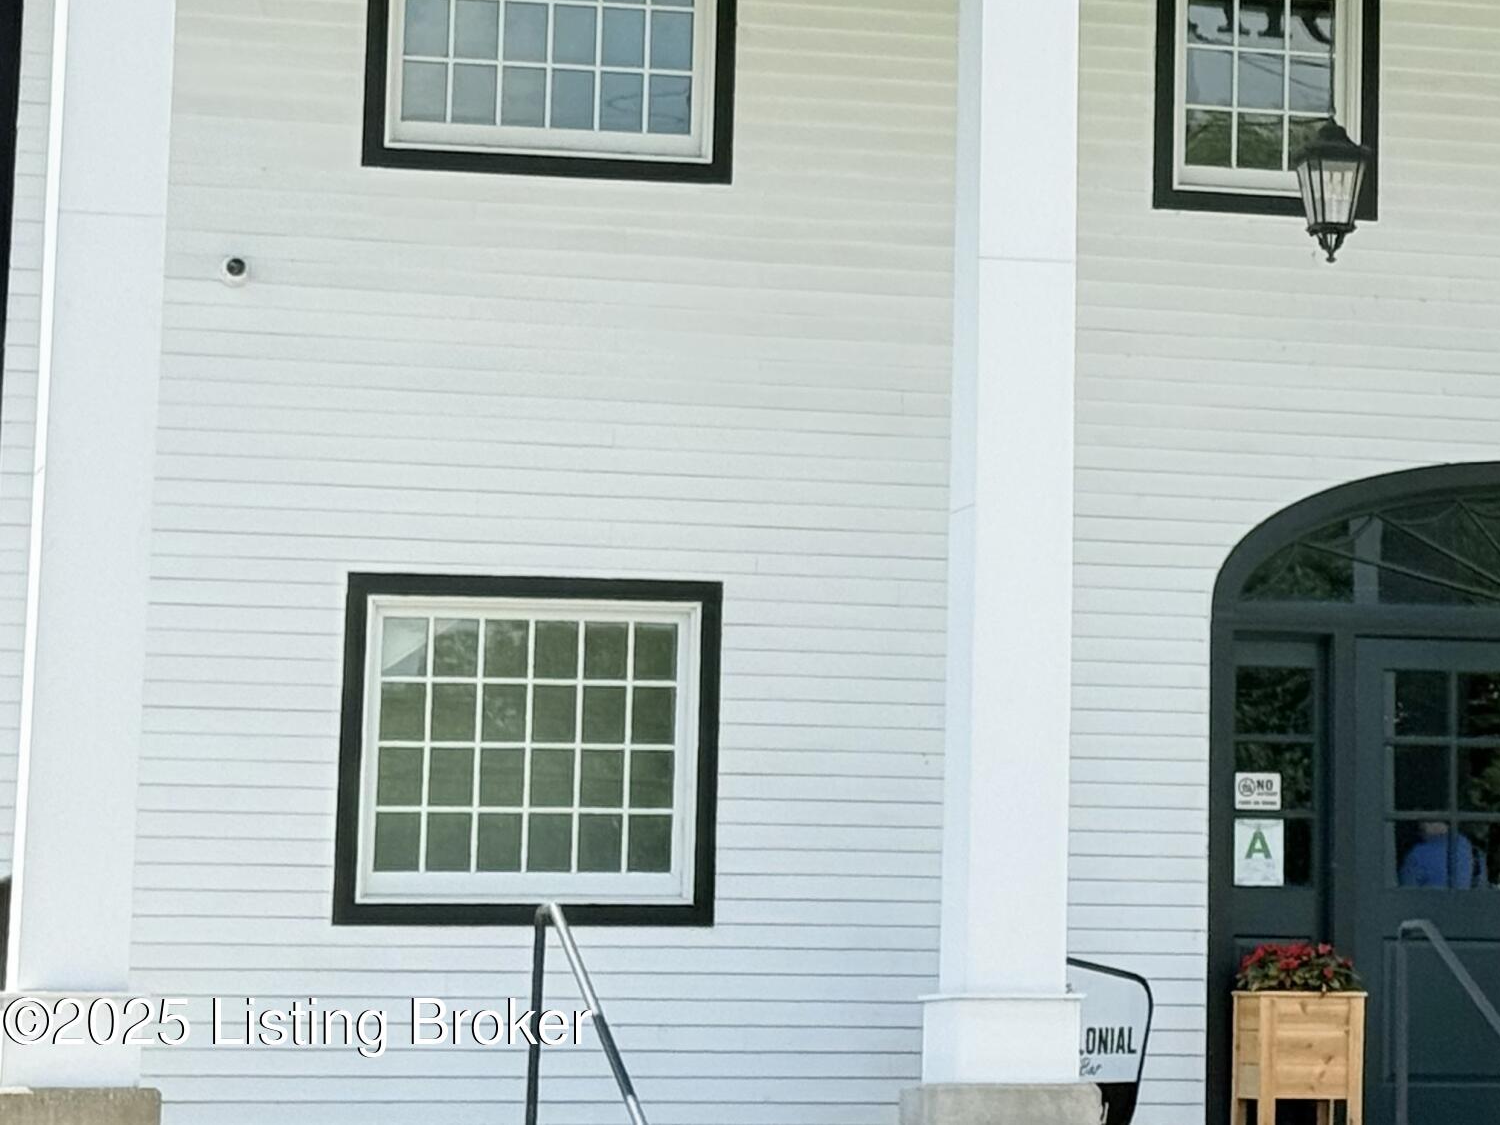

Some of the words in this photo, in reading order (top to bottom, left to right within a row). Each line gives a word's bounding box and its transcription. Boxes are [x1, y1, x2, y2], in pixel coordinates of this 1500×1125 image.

[1256, 779, 1273, 791] NO
[1244, 830, 1273, 860] A
[1079, 1026, 1137, 1056] ONIAL
